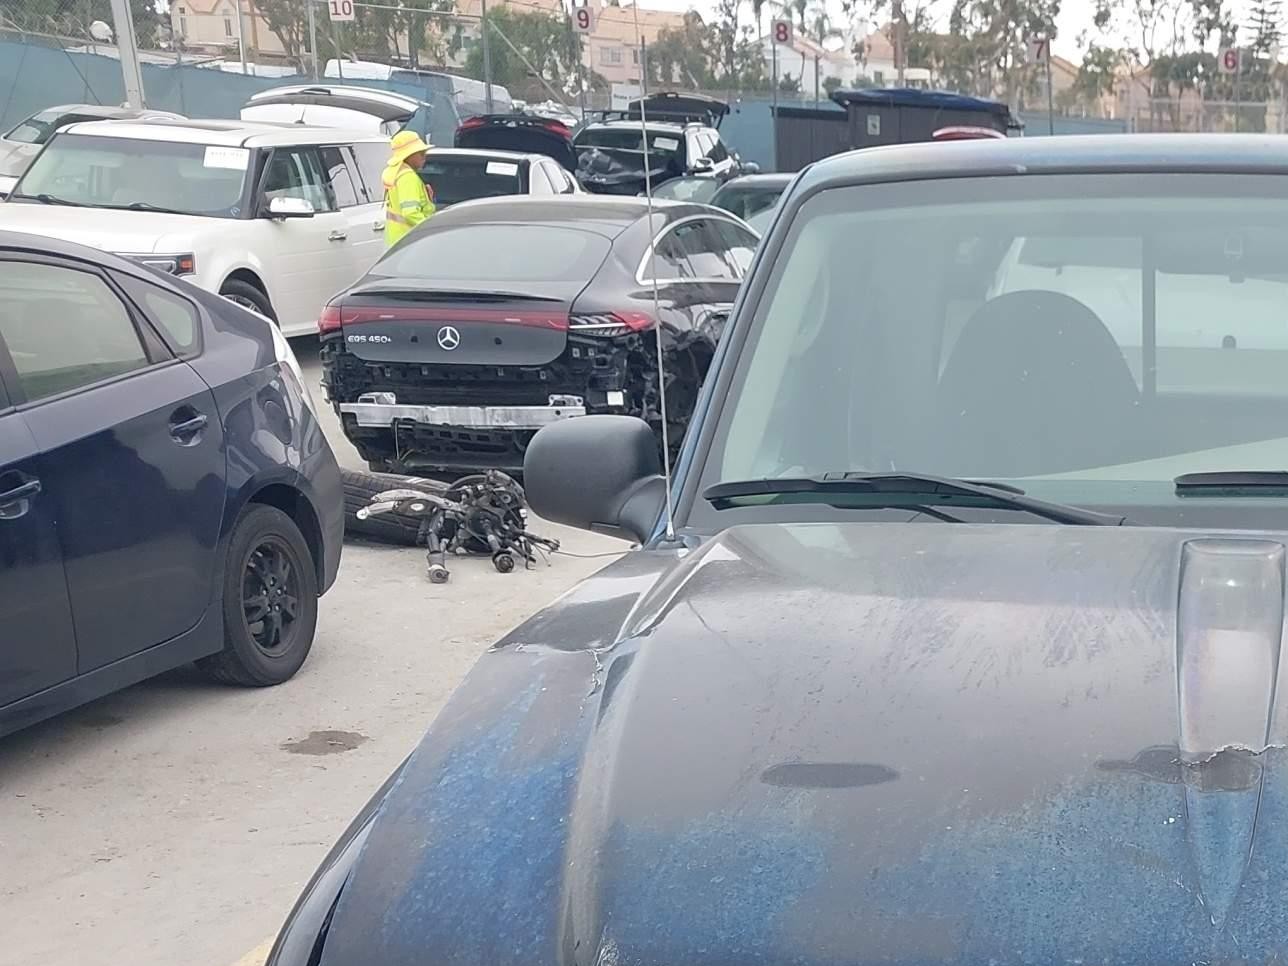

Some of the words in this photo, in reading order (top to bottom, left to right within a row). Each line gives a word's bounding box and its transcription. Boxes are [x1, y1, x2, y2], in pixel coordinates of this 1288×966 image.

[330, 0, 352, 16] 10
[577, 9, 589, 29] 9
[776, 22, 788, 42] 8
[1032, 40, 1044, 59] 7
[1225, 50, 1236, 70] 6
